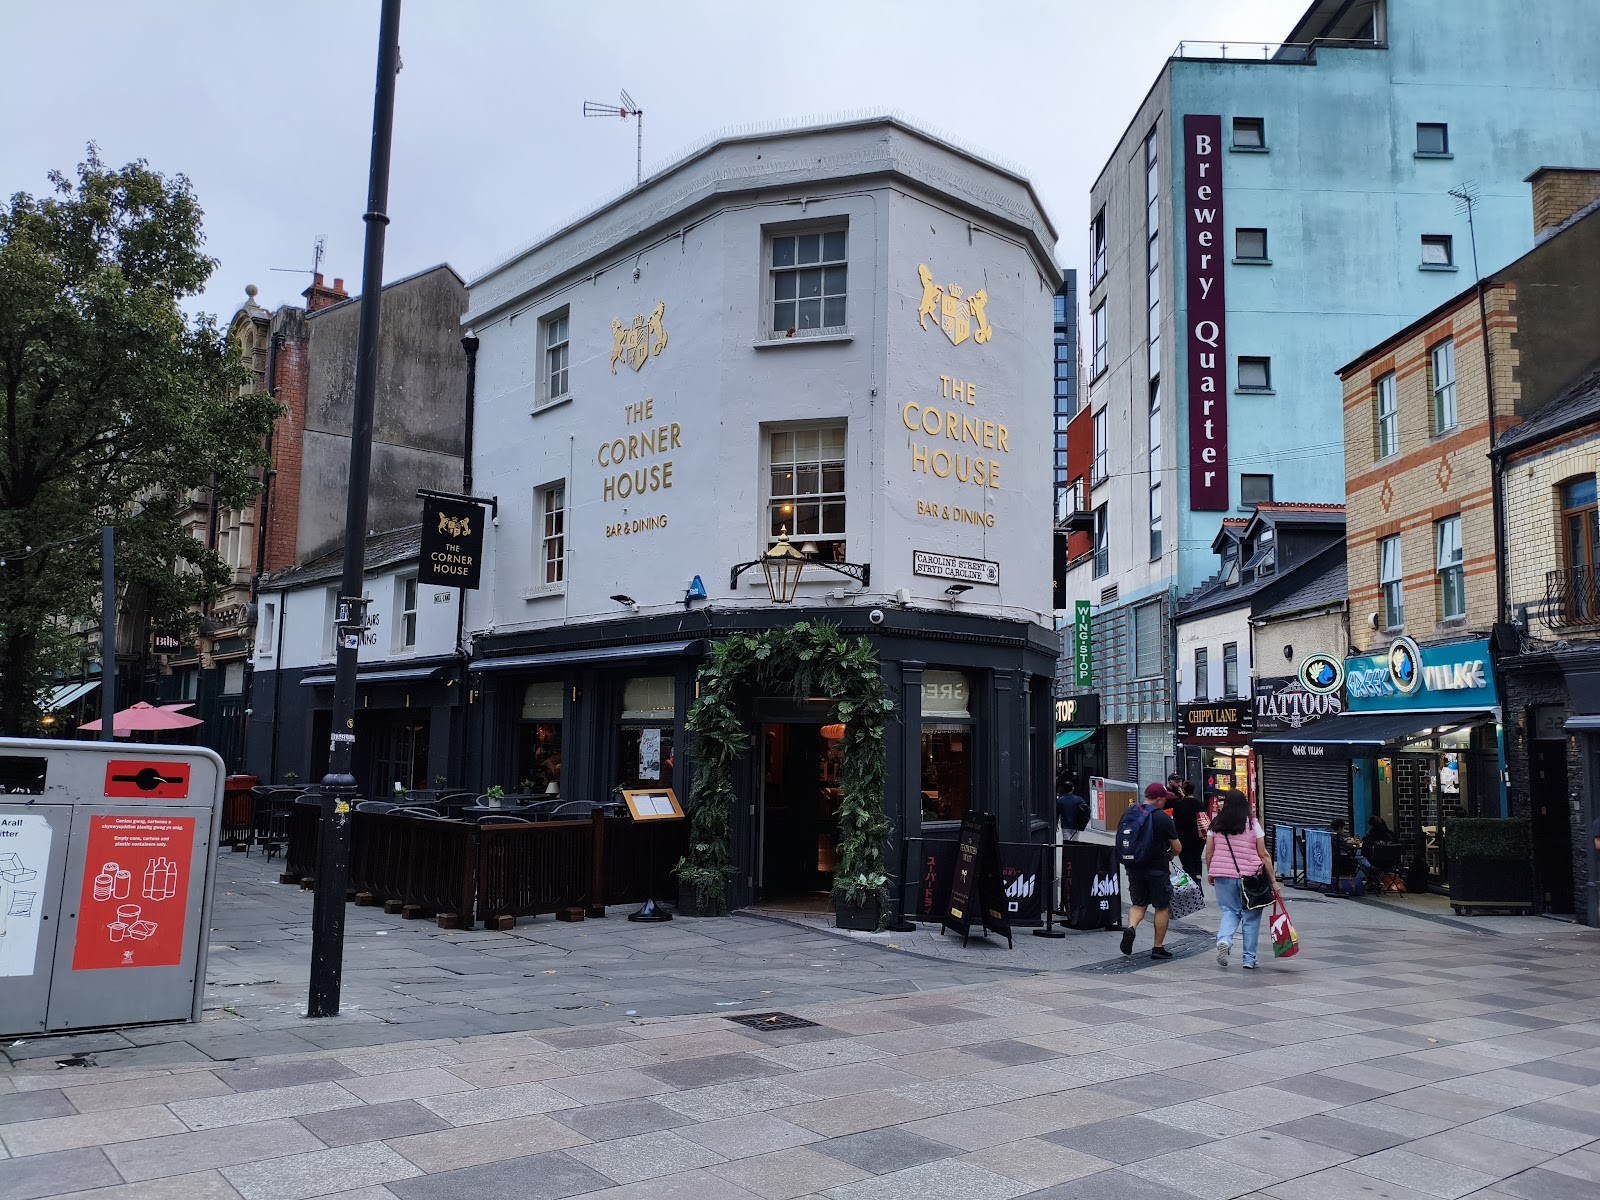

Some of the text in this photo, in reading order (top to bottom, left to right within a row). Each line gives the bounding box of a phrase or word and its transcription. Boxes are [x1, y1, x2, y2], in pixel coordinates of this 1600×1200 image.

[1194, 134, 1219, 487] Brewery Quarter
[940, 374, 976, 406] THE
[625, 398, 653, 425] THE
[902, 401, 1009, 452] CORNER
[598, 422, 681, 468] CORNER
[912, 443, 1000, 489] HOUSE
[603, 461, 673, 502] HOUSE
[606, 514, 668, 538] BAR & DINING
[917, 500, 995, 527] BAR & DINING
[431, 552, 473, 566] CORNER
[446, 543, 460, 553] THE
[433, 563, 469, 576] HOUSE
[917, 554, 986, 572] CAROLINE STREET
[917, 563, 982, 580] STRYD CAROLINE
[1346, 659, 1487, 698] GREEK VILLAGE
[1188, 709, 1215, 724] CHIPPY
[1215, 708, 1238, 723] LANE
[1256, 692, 1342, 716] TATTOOS
[1196, 726, 1229, 737] EXPRESS
[1003, 873, 1036, 898] ahi
